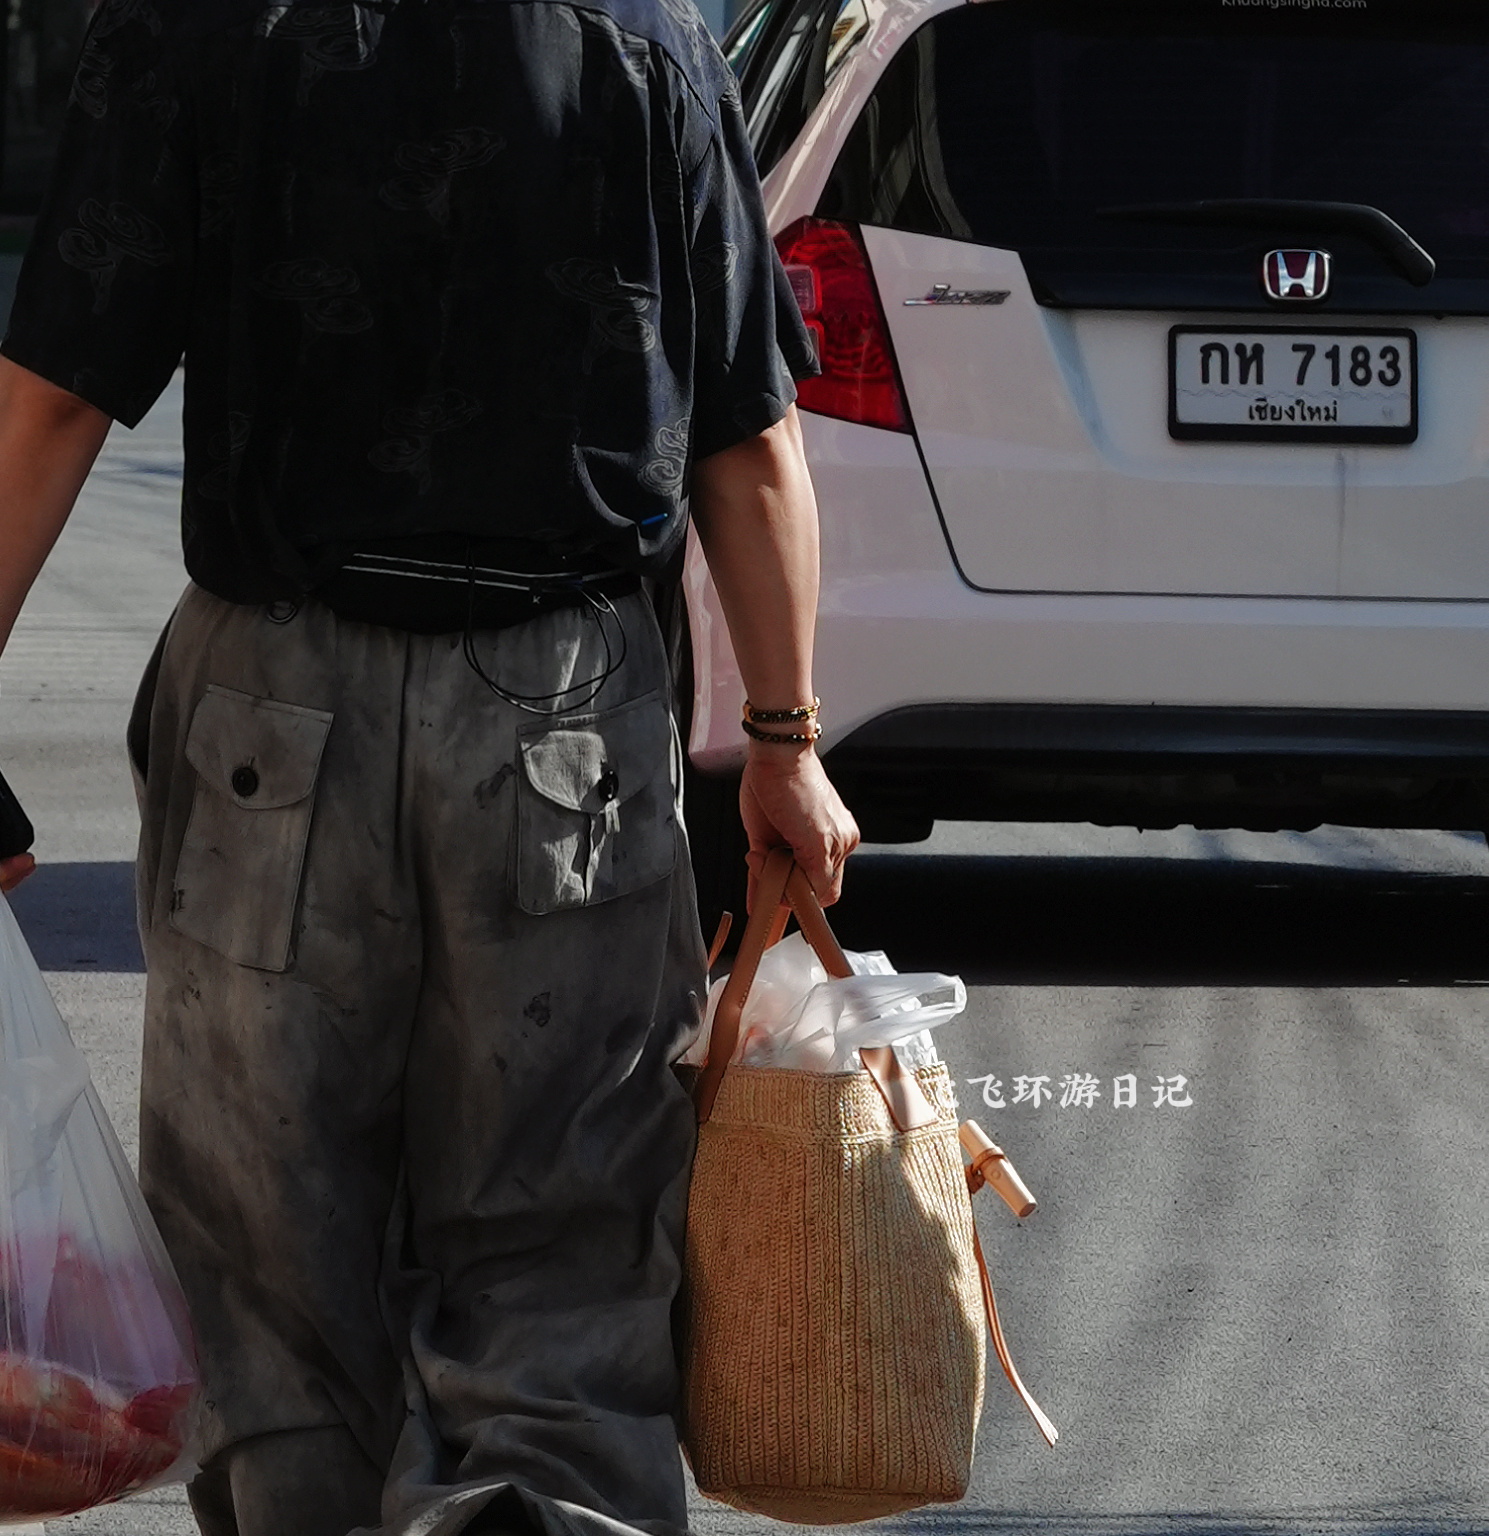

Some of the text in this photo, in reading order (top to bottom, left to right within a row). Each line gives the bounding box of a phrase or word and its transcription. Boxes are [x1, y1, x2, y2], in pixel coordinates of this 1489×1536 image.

[1291, 343, 1402, 387] 7183
[1248, 396, 1339, 422] เชียงใหม่
